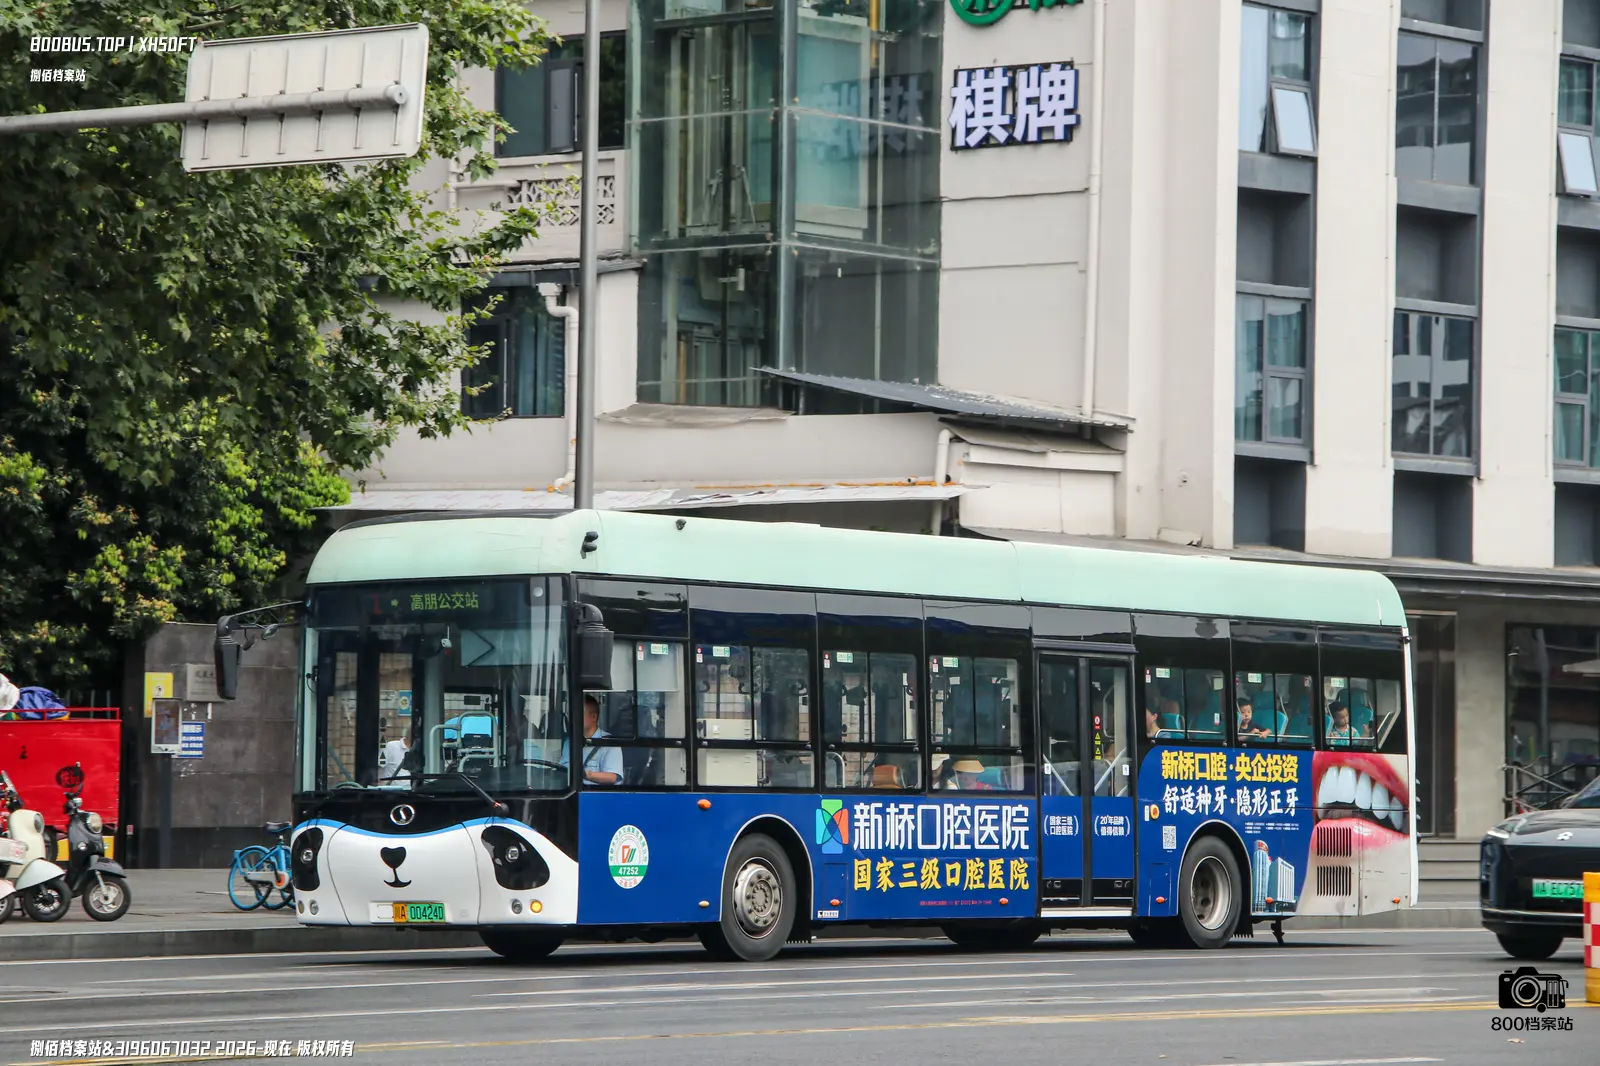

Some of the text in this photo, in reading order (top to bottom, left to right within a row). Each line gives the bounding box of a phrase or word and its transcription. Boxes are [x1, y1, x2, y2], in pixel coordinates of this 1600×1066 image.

[949, 63, 1081, 148] 棋牌
[410, 592, 479, 611] 高朋公交站
[853, 802, 1030, 850] 新桥口腔医院
[618, 866, 639, 876] 47252
[853, 856, 1030, 893] 国家三级口腔医院
